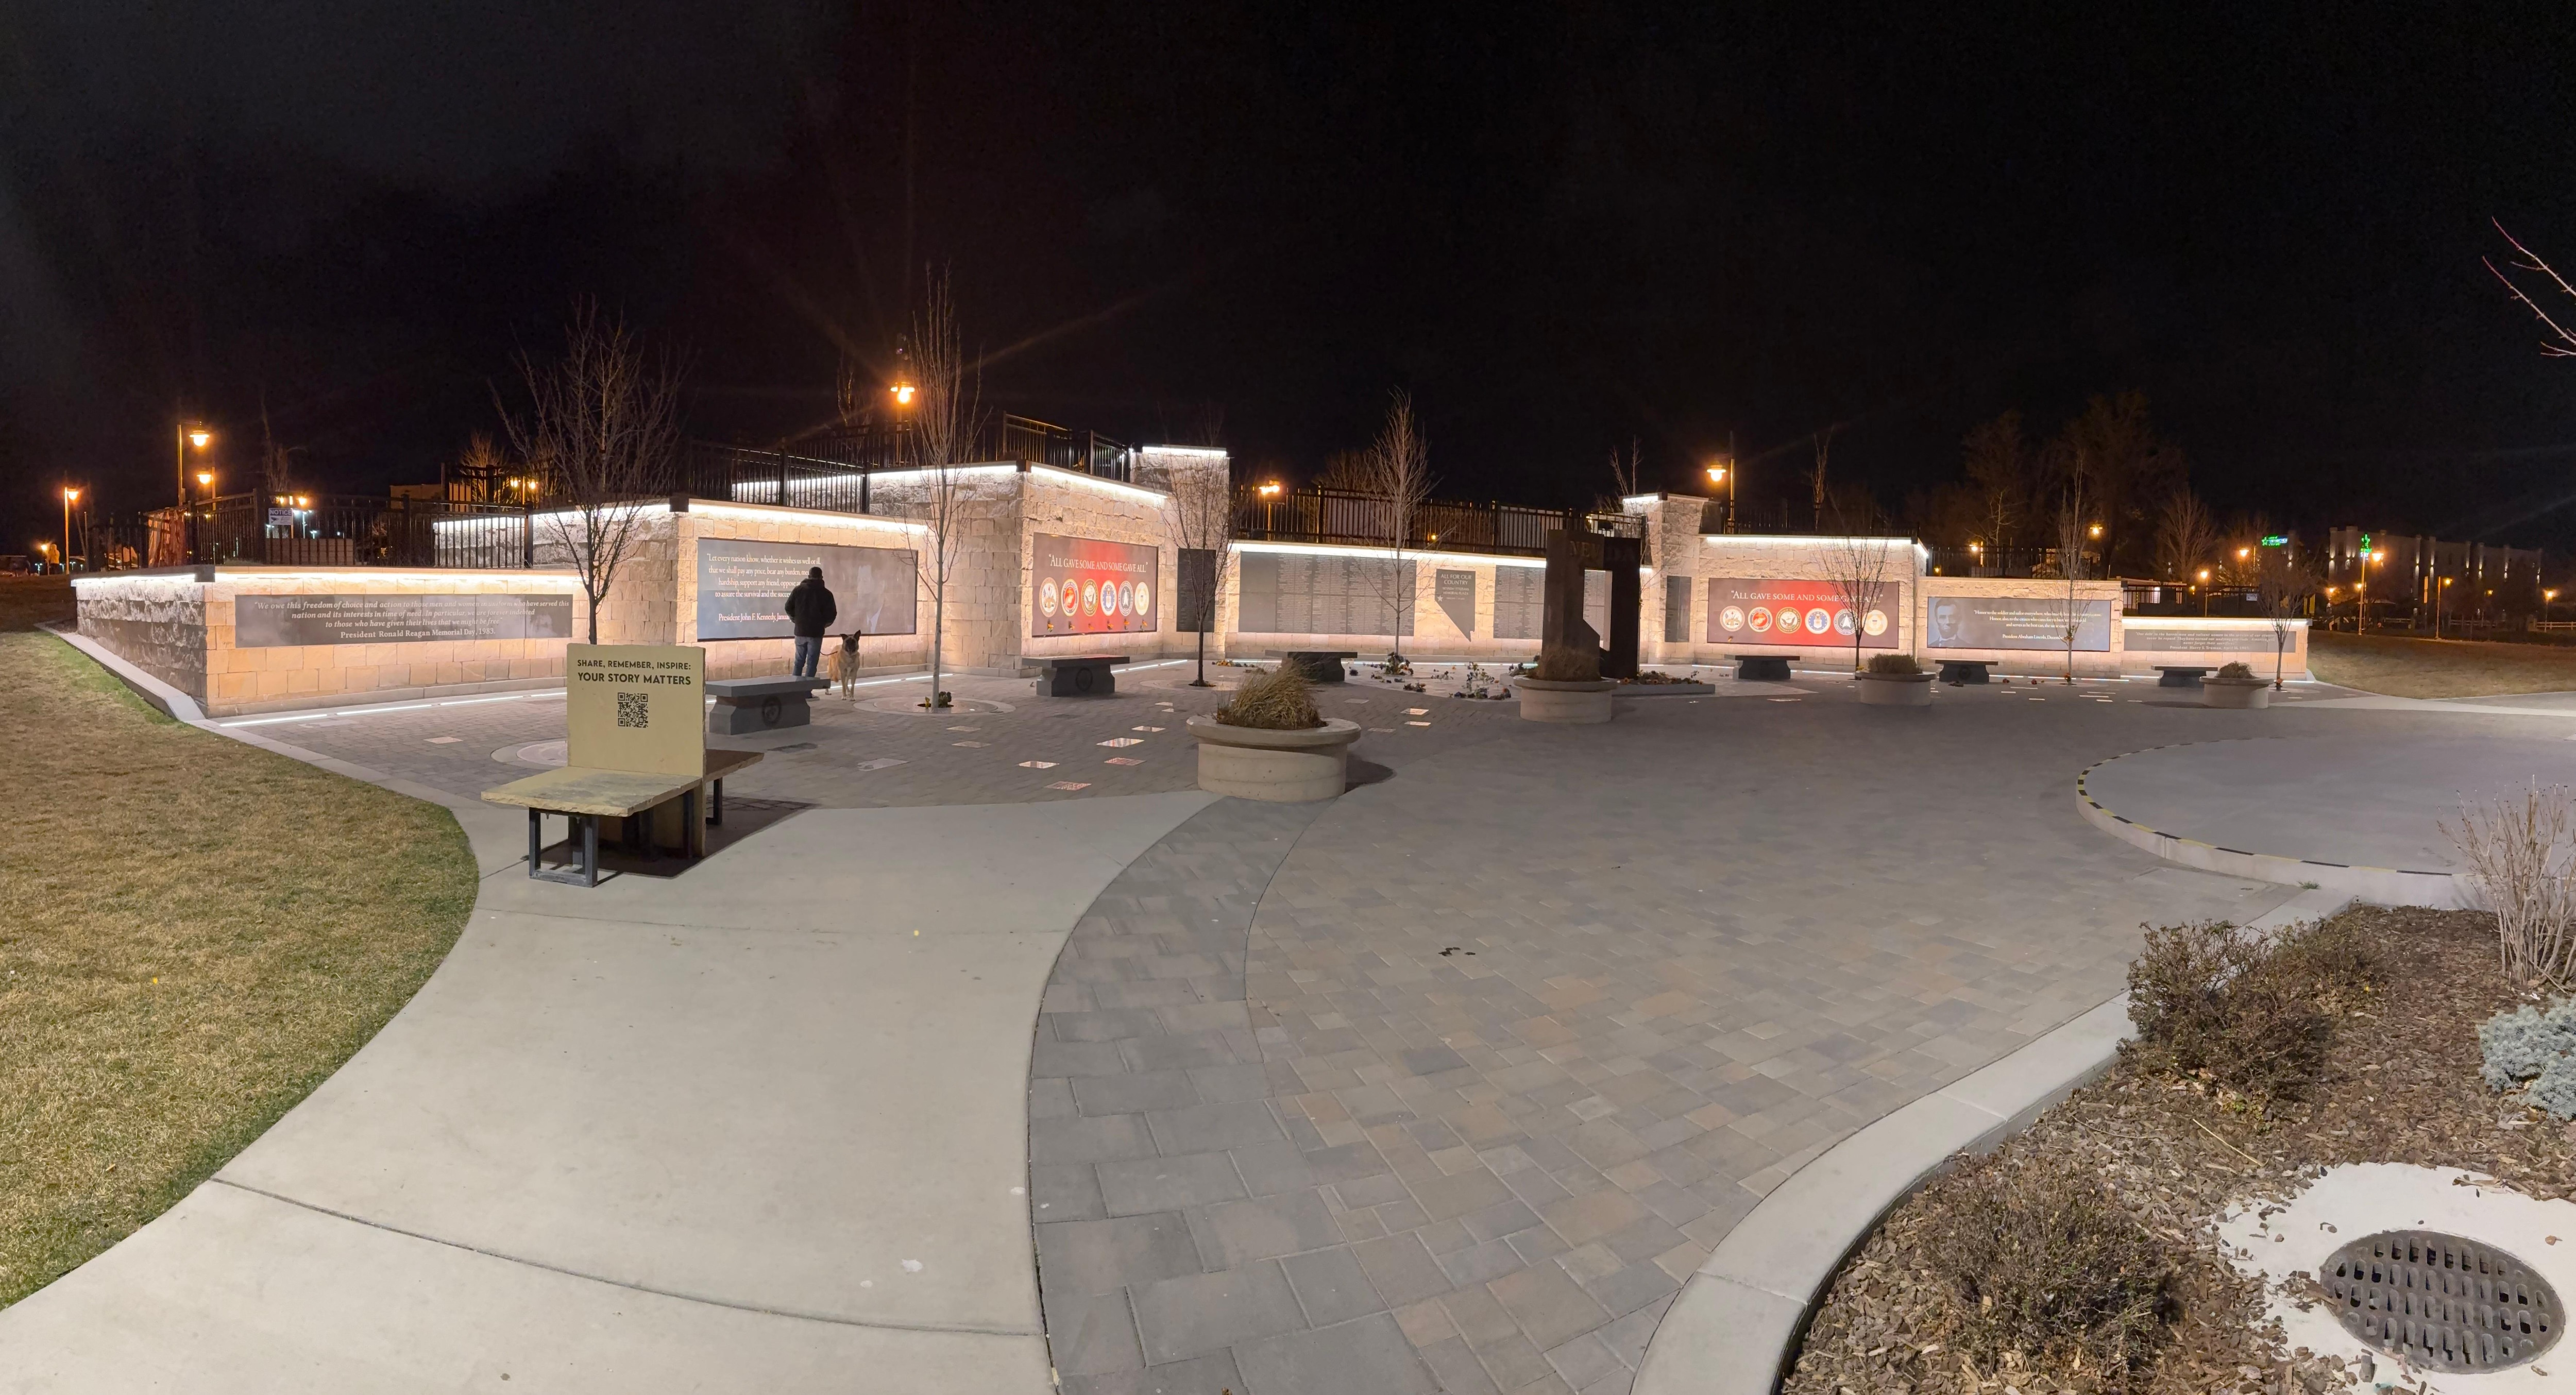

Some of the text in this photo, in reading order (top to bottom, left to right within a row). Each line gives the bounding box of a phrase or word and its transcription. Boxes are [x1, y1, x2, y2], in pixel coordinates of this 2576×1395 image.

[717, 556, 731, 564] every
[746, 554, 760, 563] know,
[783, 556, 796, 564] wishes
[1063, 558, 1079, 568] GAVE
[1079, 559, 1095, 569] SOME
[1096, 561, 1108, 570] AND
[1108, 562, 1123, 571] SOME
[1123, 563, 1137, 572] GAVE
[754, 568, 767, 576] price,
[767, 567, 776, 575] bear
[785, 567, 801, 575] burden,
[718, 577, 739, 588] hardship,
[739, 580, 757, 588] support
[766, 578, 780, 586] friend,
[302, 601, 333, 610] freedom
[333, 601, 342, 610] of
[398, 610, 407, 618] of
[433, 610, 467, 618] particular,
[740, 613, 751, 622] John
[756, 613, 776, 622] Kennedy,
[386, 620, 404, 628] given
[578, 659, 691, 670] SHARE, REMEMBER, INSPIRE:
[578, 672, 691, 685] YOUR STORY MATTERS
